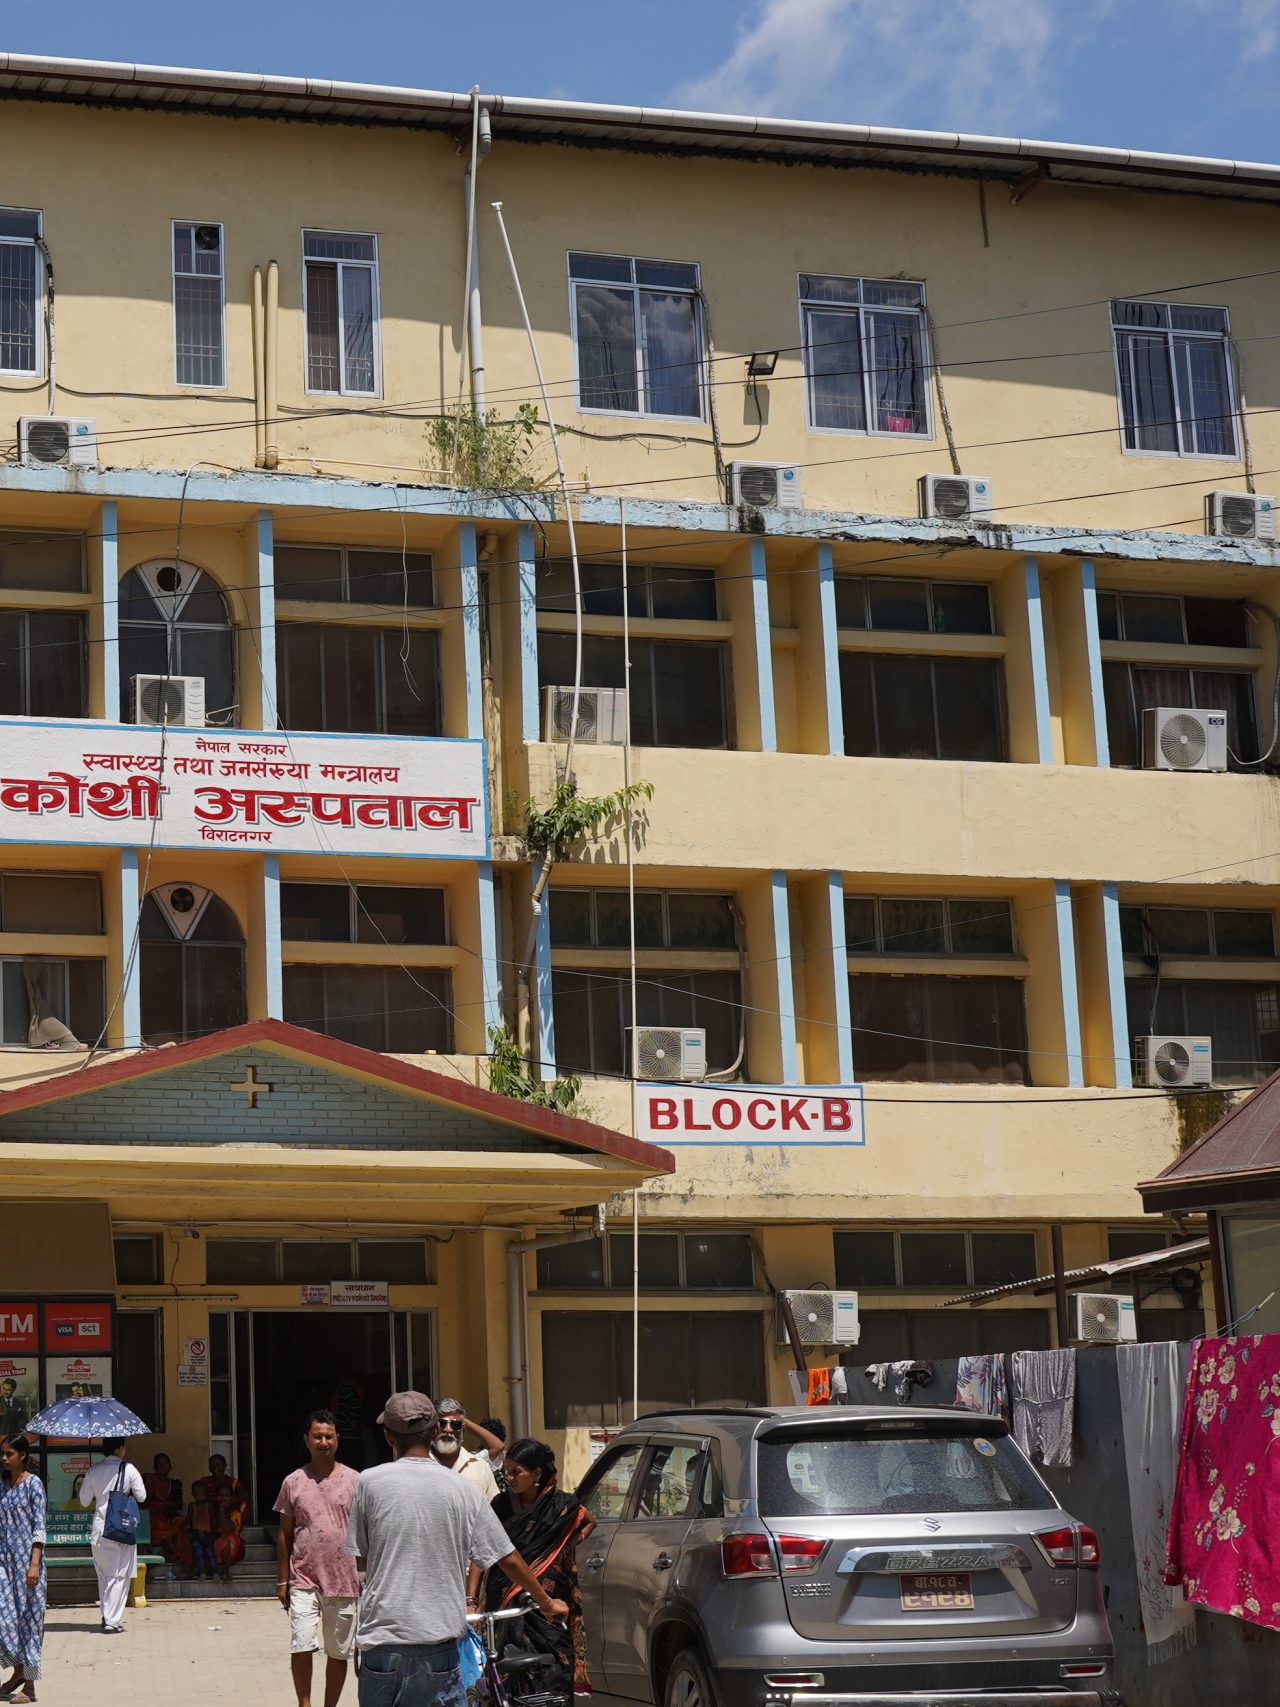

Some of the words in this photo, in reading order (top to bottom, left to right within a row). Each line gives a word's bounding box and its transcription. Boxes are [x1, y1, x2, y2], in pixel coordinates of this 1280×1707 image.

[195, 737, 230, 754] नेपाल
[238, 741, 287, 757] सरकार
[83, 752, 164, 774] स्वास्थ्य
[173, 757, 214, 778] तथा
[218, 754, 311, 781] जनसंख्या
[319, 763, 400, 785] मन्त्रालय
[0, 772, 168, 820] कोशी
[194, 786, 477, 830] अस्पताल
[198, 827, 273, 845] विराटनगर
[648, 1097, 853, 1132] BLOCK-B
[57, 1326, 73, 1334] VISA
[82, 1324, 97, 1333] sct
[885, 1556, 991, 1570] BREZZA
